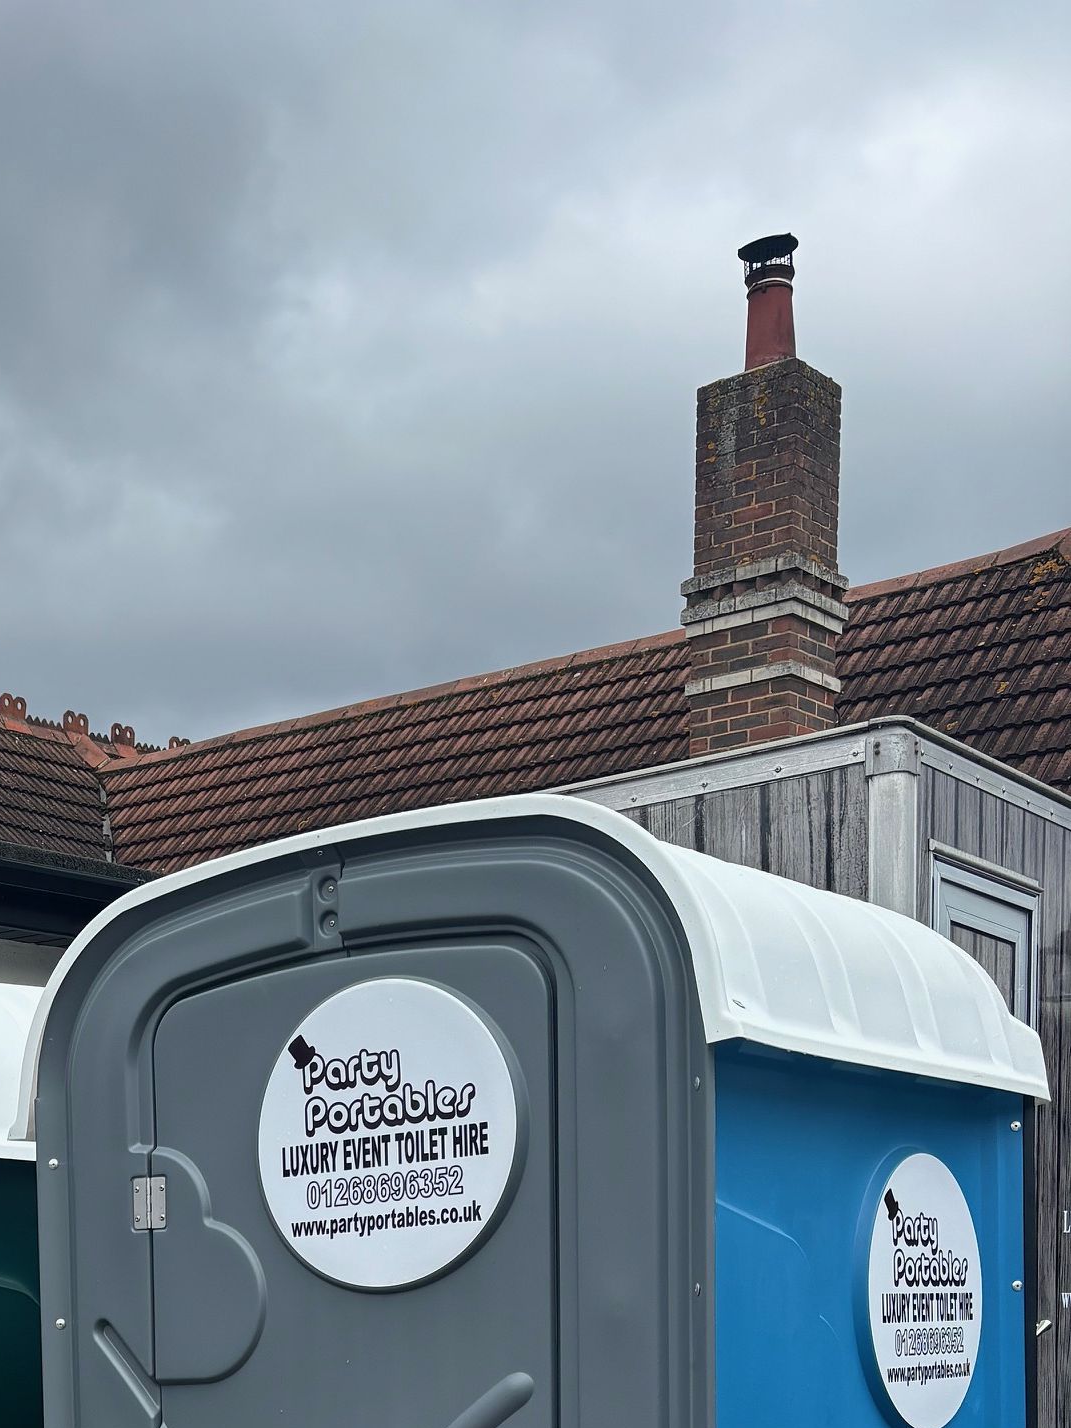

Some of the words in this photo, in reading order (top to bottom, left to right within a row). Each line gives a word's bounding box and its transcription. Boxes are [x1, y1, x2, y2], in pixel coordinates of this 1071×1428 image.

[301, 1049, 401, 1094] Party
[305, 1079, 475, 1137] Portables
[282, 1141, 338, 1178] LUXURY
[343, 1134, 390, 1171] EVENT
[395, 1127, 447, 1164] TOILET
[452, 1122, 489, 1158] HIRE
[307, 1165, 463, 1210] 01268696352
[291, 1200, 482, 1239] www.partyportables.co.uk
[892, 1208, 938, 1255] Party
[893, 1250, 968, 1287] Portables
[882, 1293, 911, 1323] LUXURY
[913, 1293, 934, 1322] EVENT
[935, 1293, 957, 1322] TOILET
[959, 1292, 973, 1320] HIRE
[895, 1327, 964, 1356] 01268696352
[887, 1358, 970, 1386] www.partyportables.co.uk
